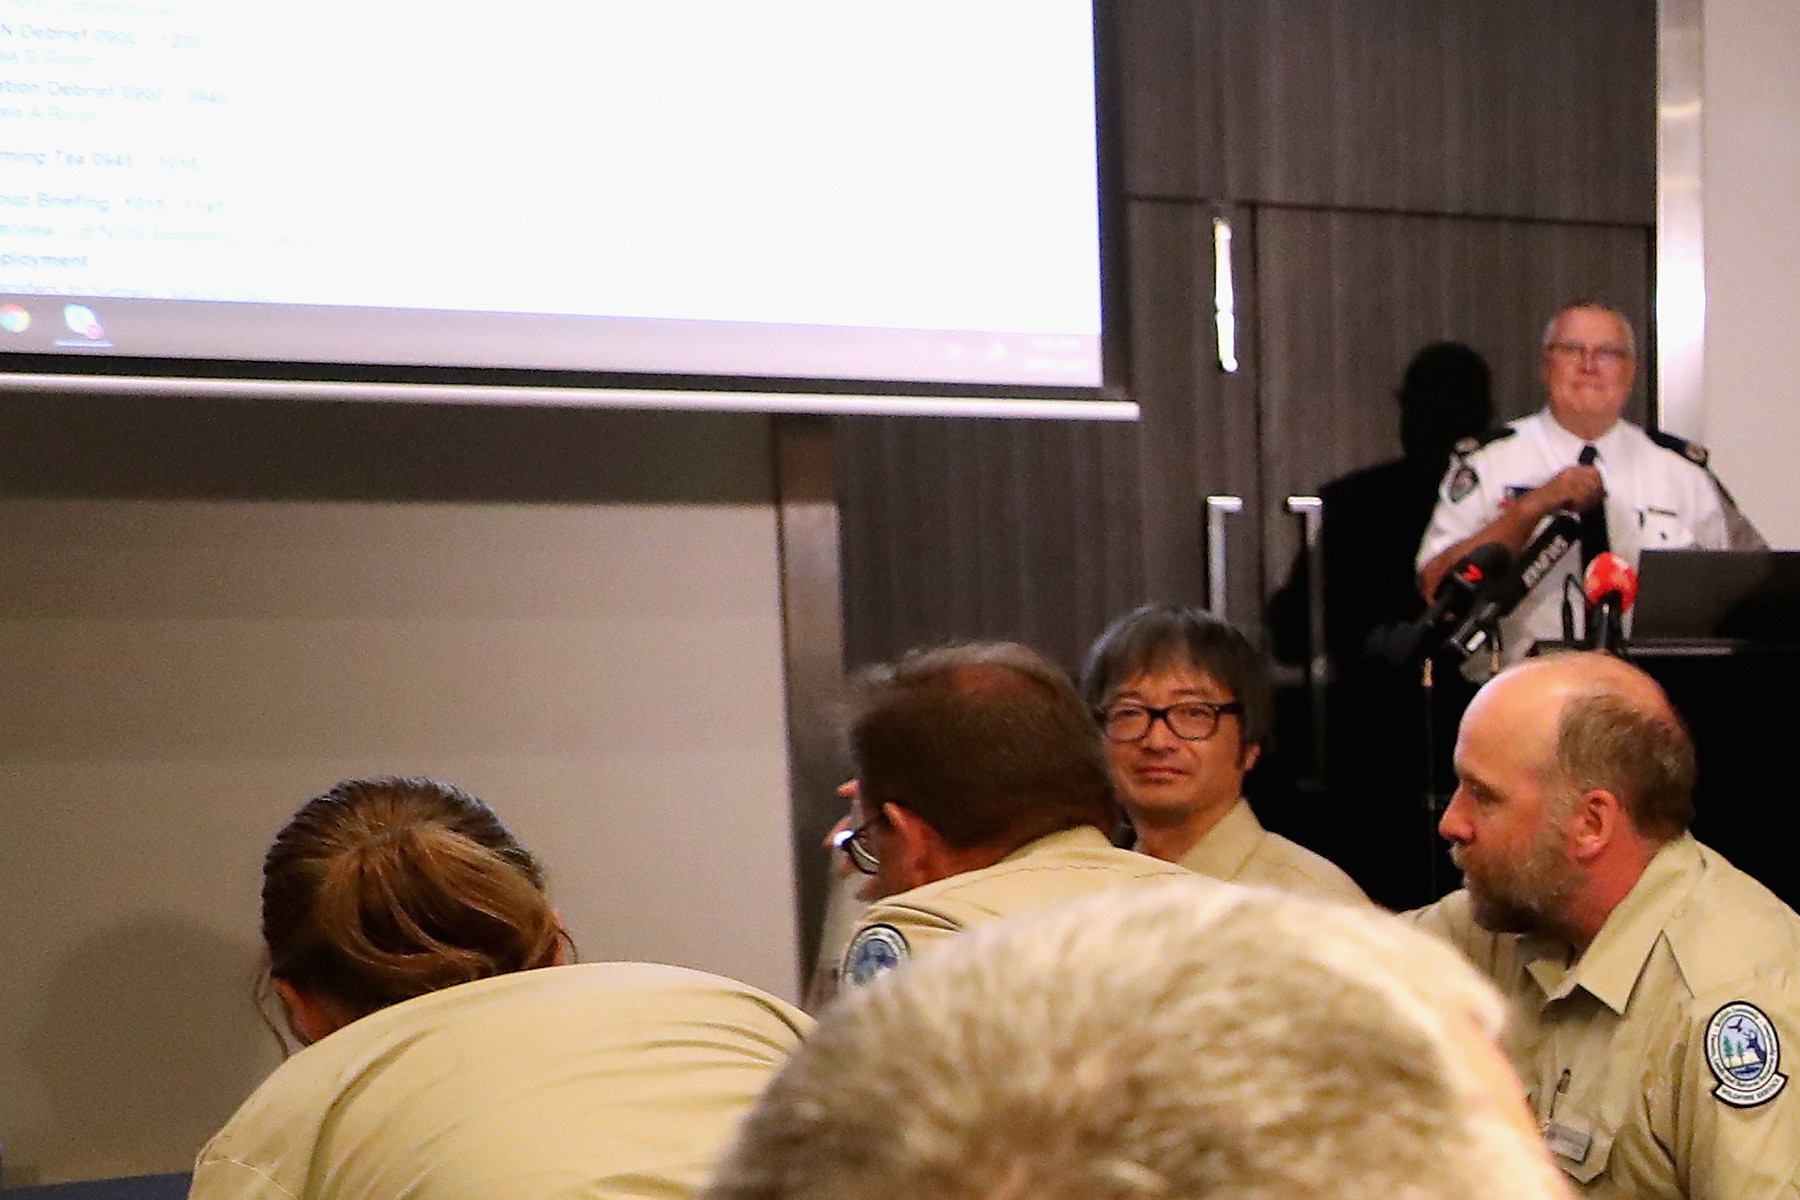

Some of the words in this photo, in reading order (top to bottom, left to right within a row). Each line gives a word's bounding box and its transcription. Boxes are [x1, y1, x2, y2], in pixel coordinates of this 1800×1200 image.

[20, 23, 87, 41] Debrief
[47, 81, 114, 98] Debrief
[36, 192, 111, 214] Briefing
